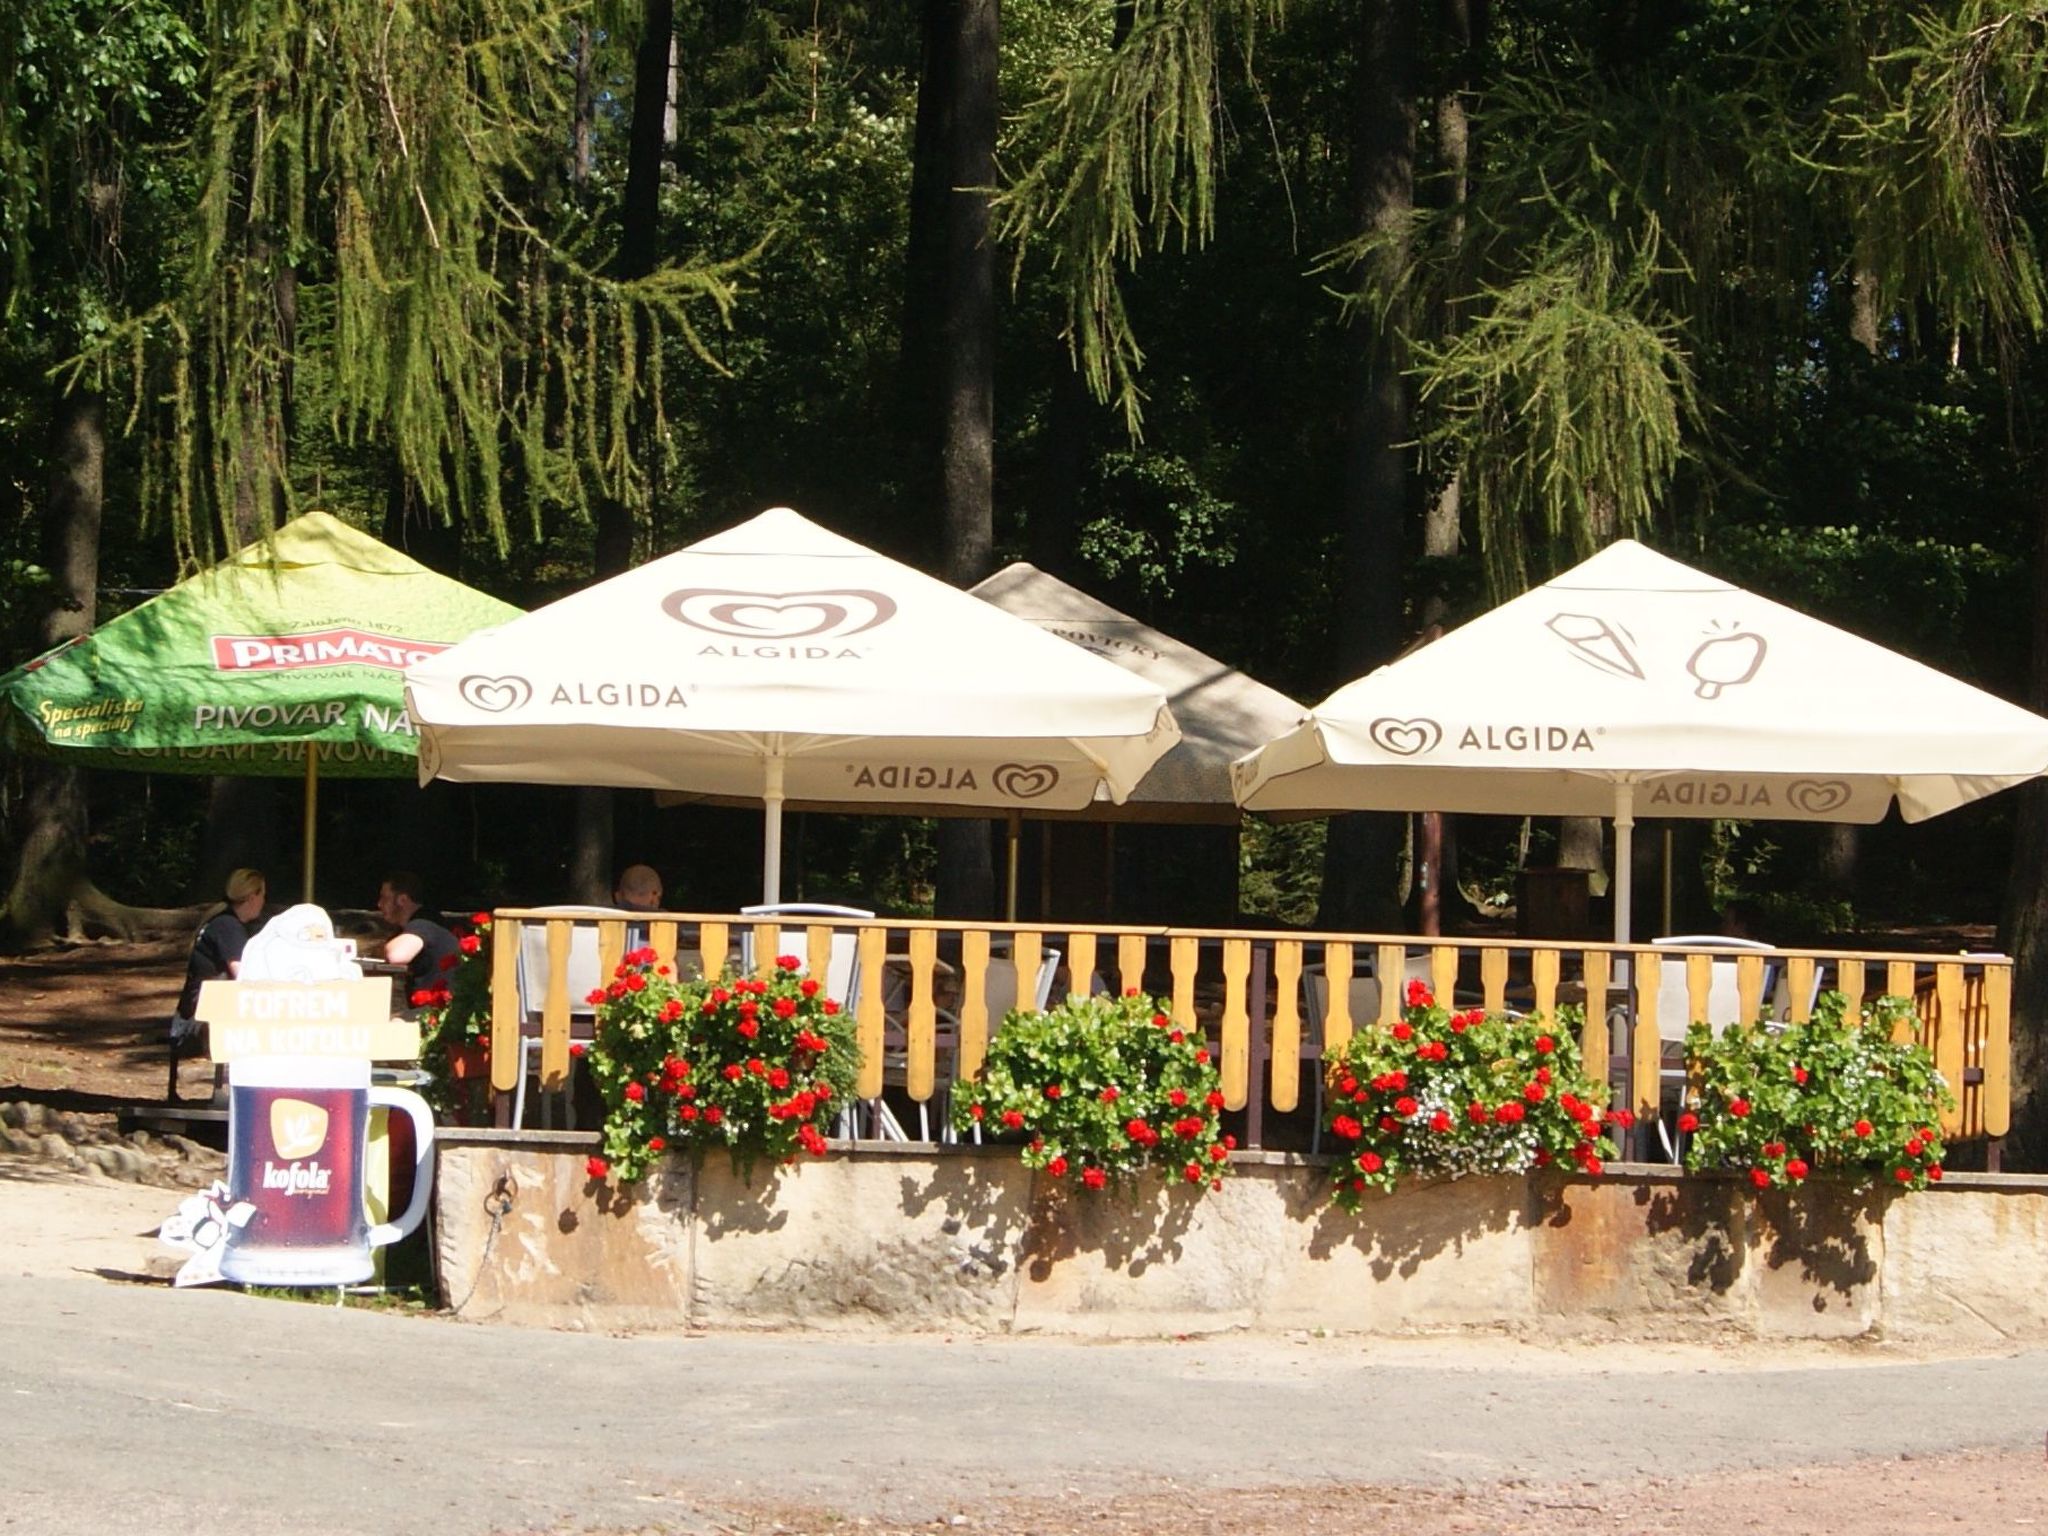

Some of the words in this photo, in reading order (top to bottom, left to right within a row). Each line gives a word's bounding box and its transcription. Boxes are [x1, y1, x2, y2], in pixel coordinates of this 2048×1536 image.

[697, 645, 862, 659] ALGIDA
[550, 683, 688, 708] ALGIDA
[40, 698, 144, 728] Specialista
[195, 701, 347, 730] PIVOVAR
[54, 727, 72, 738] na
[1458, 725, 1594, 752] ALGIDA
[238, 990, 349, 1020] FOFREM
[271, 1026, 370, 1053] KOFOLU
[262, 1161, 332, 1196] kofola
